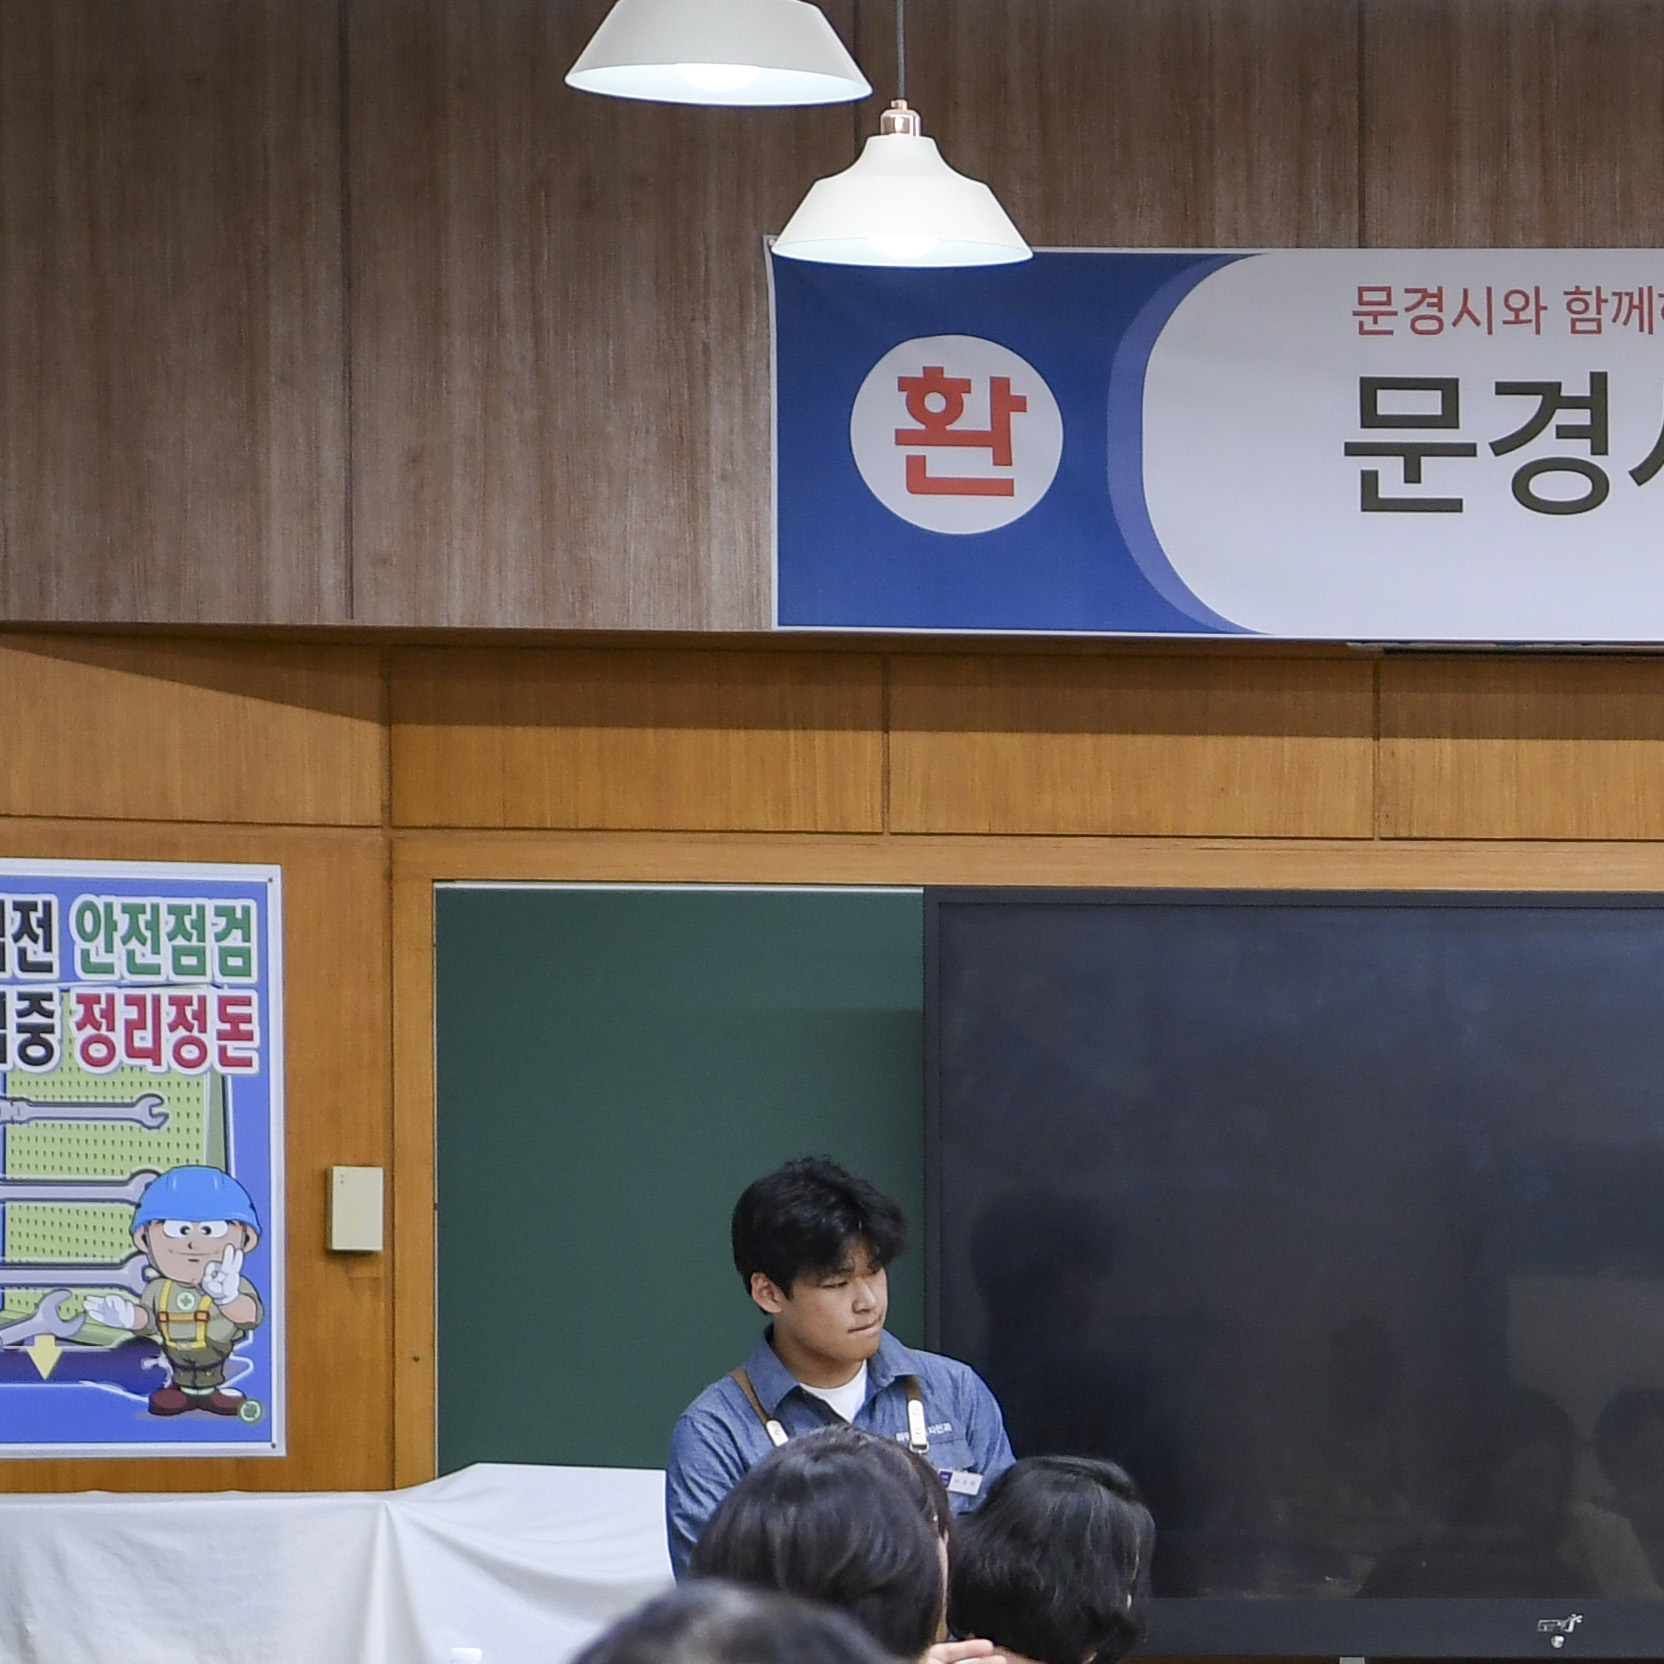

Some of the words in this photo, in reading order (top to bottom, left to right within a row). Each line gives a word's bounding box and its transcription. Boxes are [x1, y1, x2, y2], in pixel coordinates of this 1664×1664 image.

[1351, 285, 1549, 336] 문경시와
[896, 367, 1028, 497] 환
[0, 900, 54, 974] 전
[75, 900, 252, 977] 안전점검
[0, 990, 55, 1067] 중
[75, 993, 254, 1069] 정리정돈
